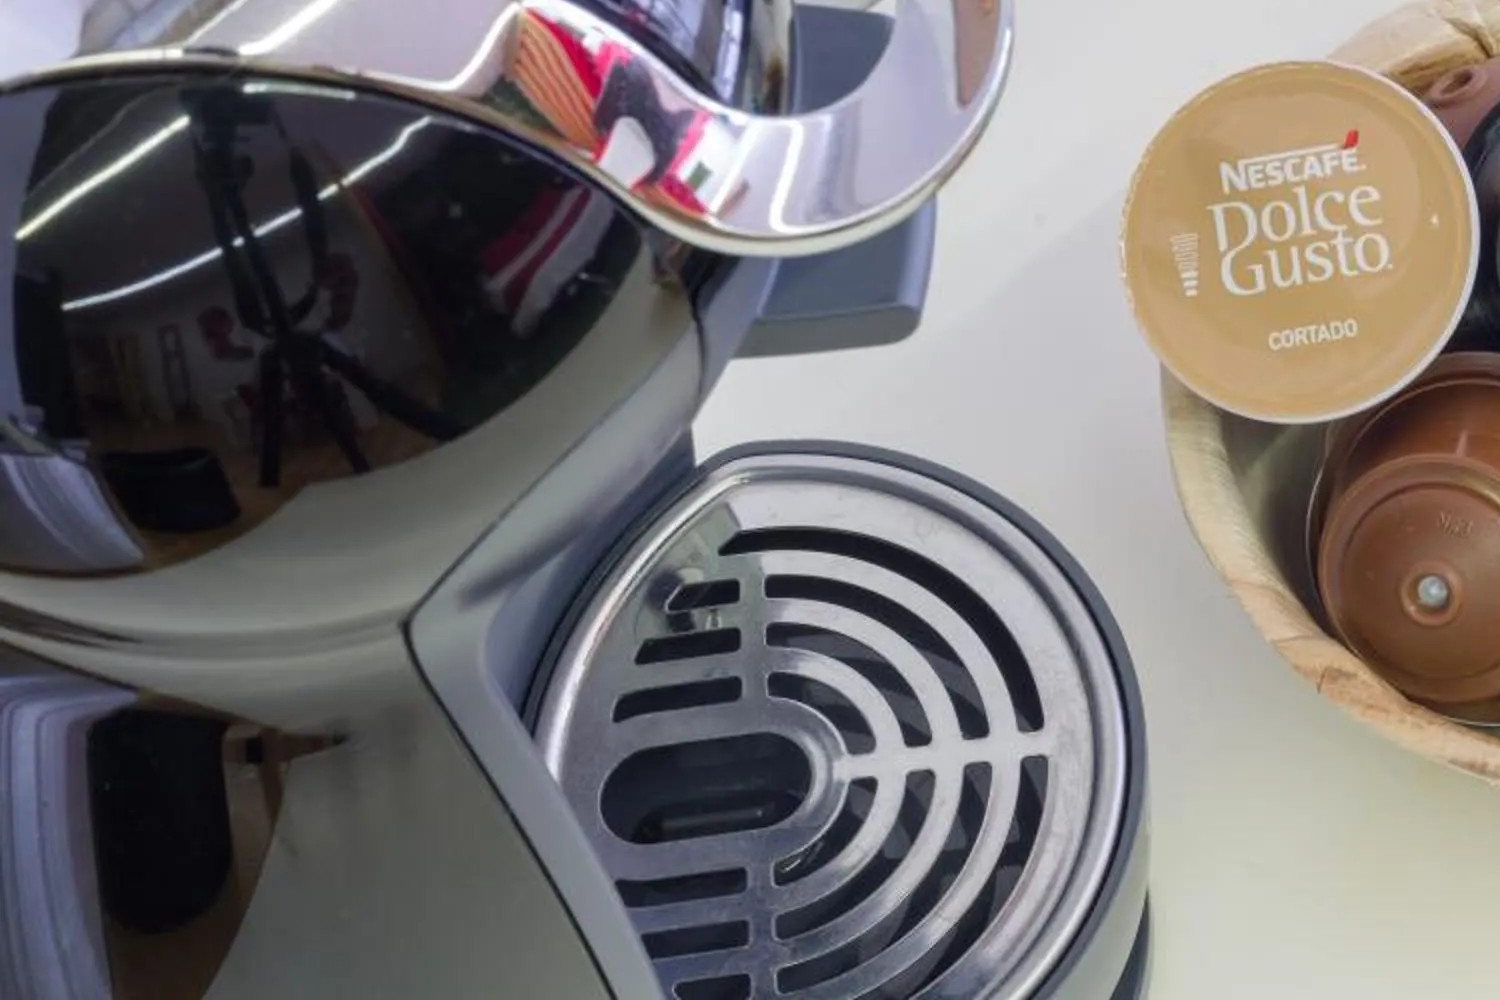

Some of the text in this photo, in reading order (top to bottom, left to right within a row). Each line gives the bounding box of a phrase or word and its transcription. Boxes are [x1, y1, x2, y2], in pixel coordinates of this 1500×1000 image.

[1219, 130, 1360, 195] NESCAFÉ
[1206, 184, 1384, 252] Dolce
[1219, 230, 1390, 296] Gusto
[1268, 318, 1358, 351] CORTADO
